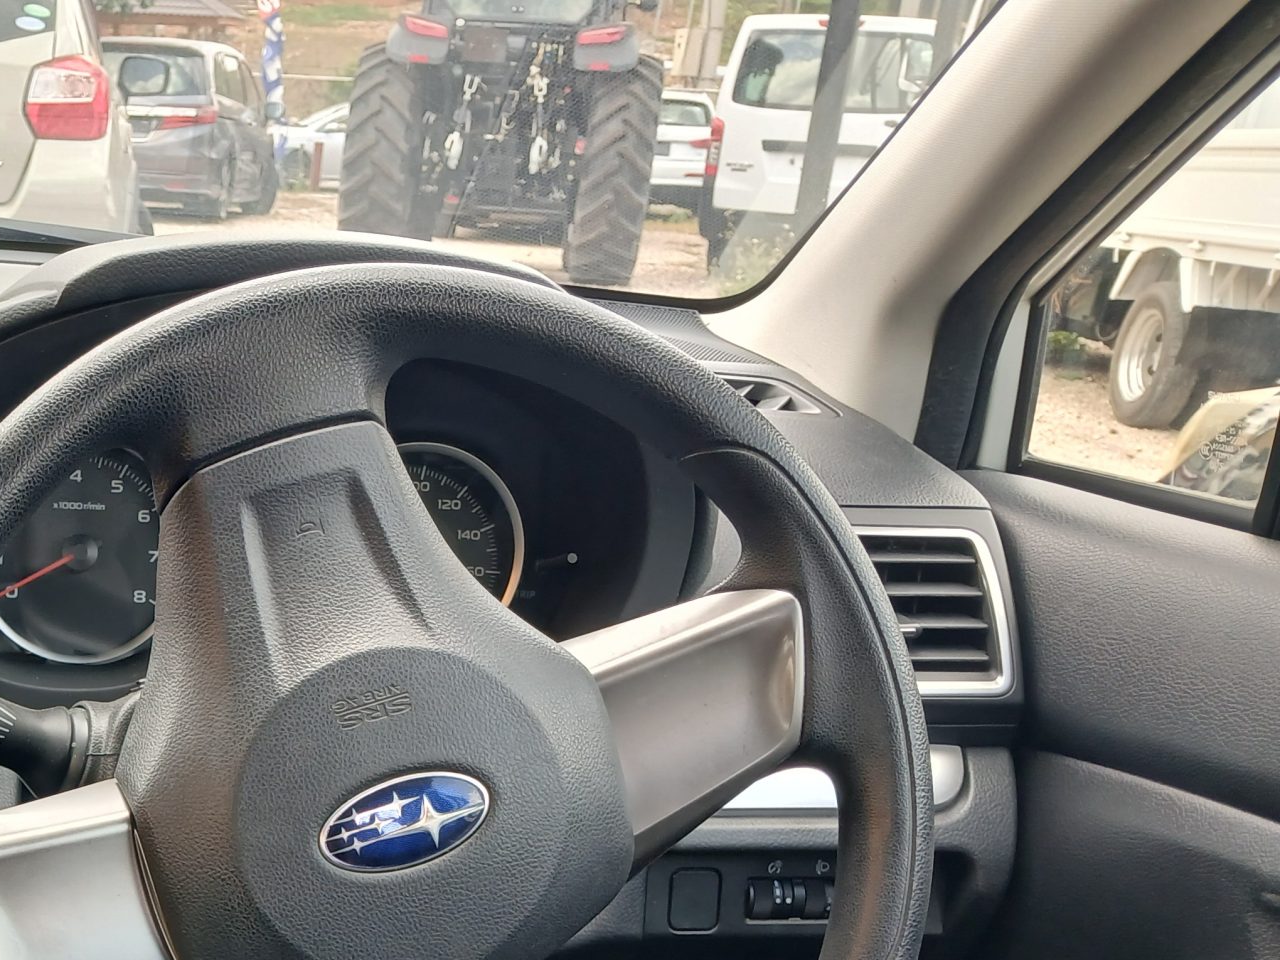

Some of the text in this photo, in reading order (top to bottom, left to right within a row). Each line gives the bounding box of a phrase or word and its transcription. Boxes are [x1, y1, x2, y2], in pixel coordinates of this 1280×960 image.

[69, 469, 83, 483] 4
[110, 479, 124, 494] 5
[413, 481, 430, 492] 00
[437, 499, 462, 510] 120
[137, 509, 151, 523] 6
[457, 529, 481, 541] 140
[148, 550, 159, 563] 7
[5, 585, 19, 599] 0
[133, 590, 147, 604] 8
[336, 696, 412, 731] SRS
